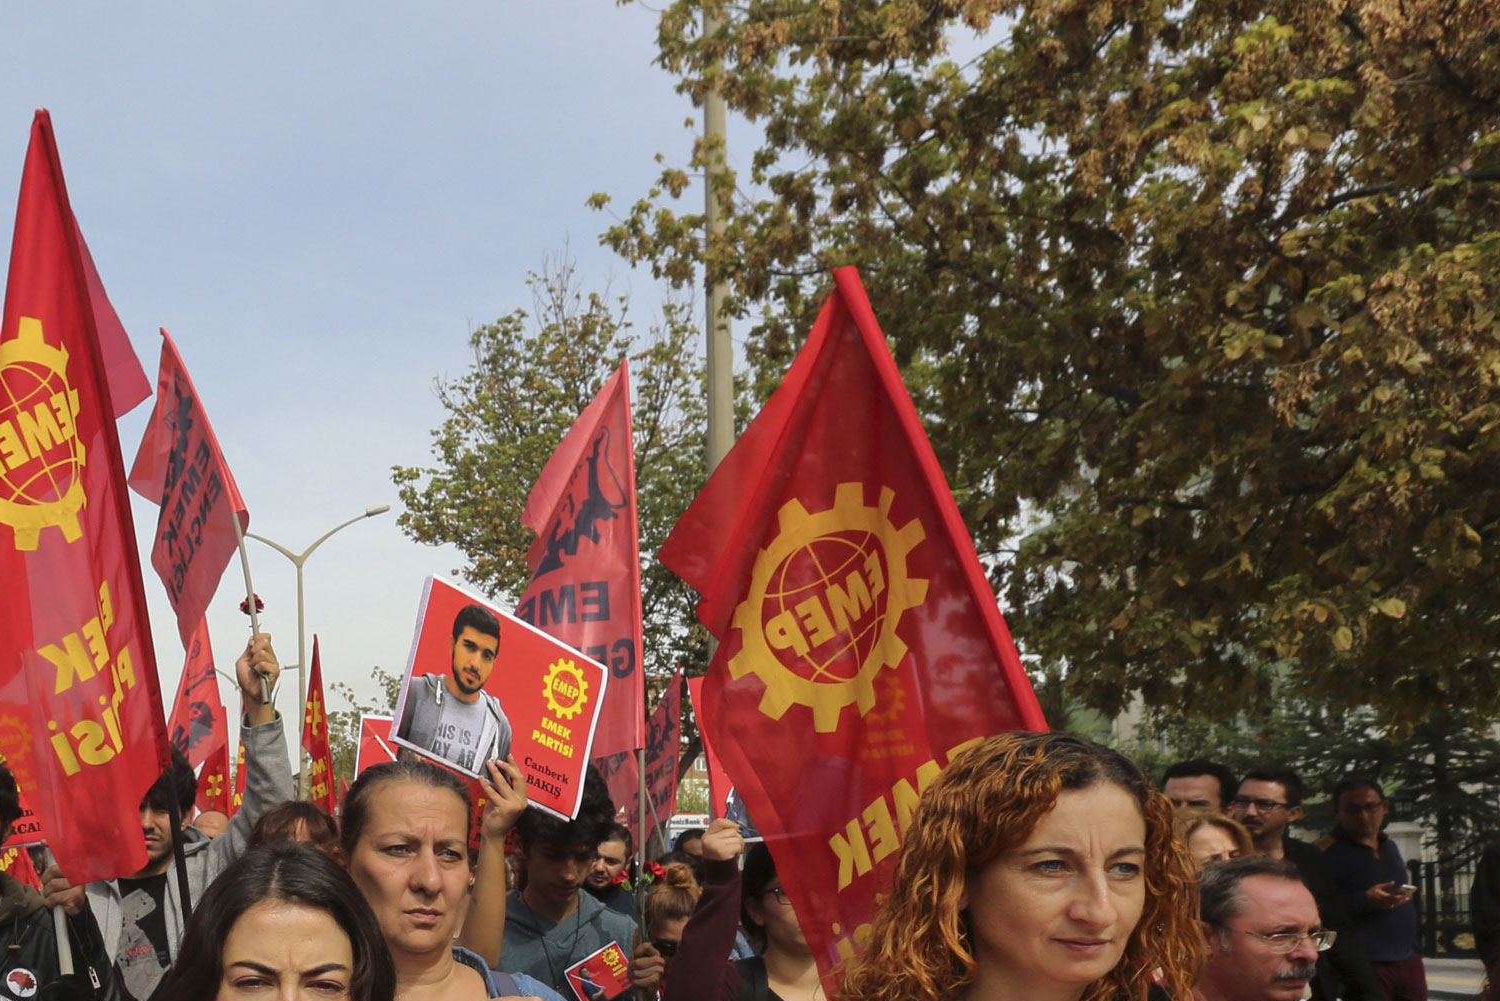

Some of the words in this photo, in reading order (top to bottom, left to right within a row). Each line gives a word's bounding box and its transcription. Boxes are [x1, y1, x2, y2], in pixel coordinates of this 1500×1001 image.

[552, 677, 580, 700] EMEP
[541, 716, 572, 741] EMEK
[531, 729, 575, 759] PARTİSİ
[524, 756, 570, 785] Canberk
[526, 773, 563, 799] BAKIŞ
